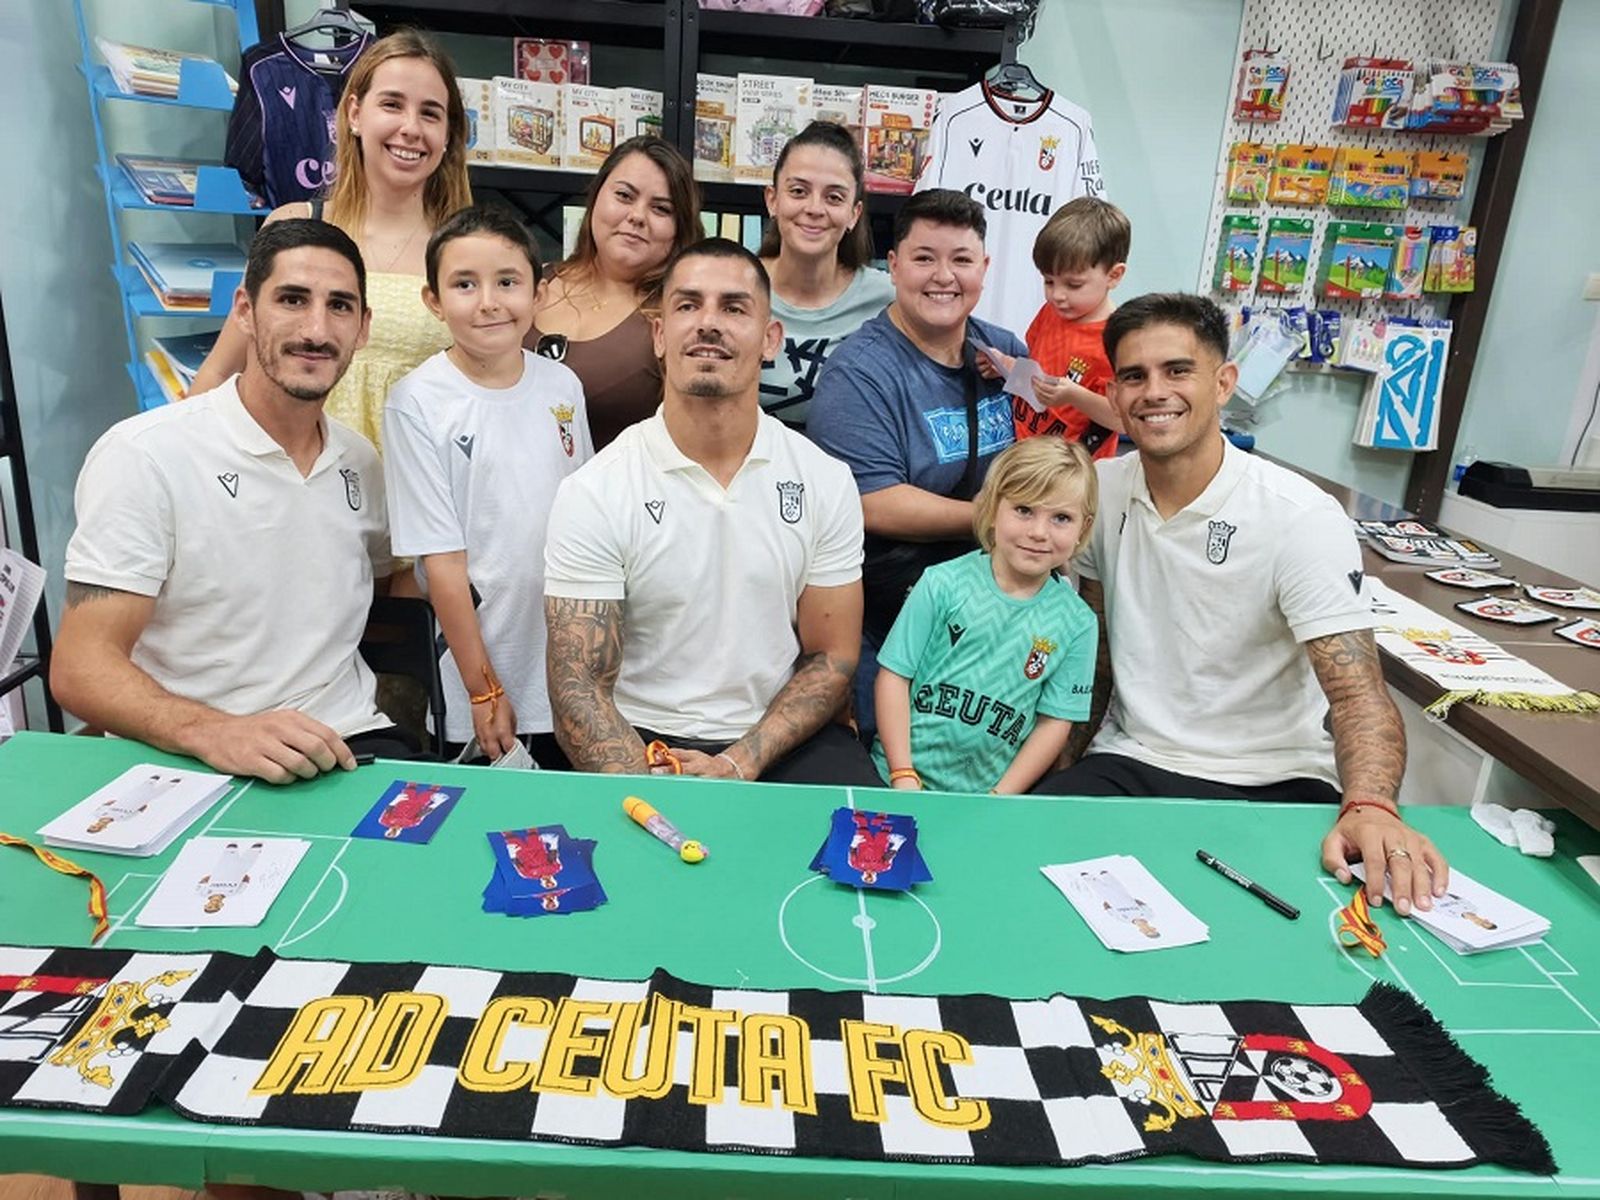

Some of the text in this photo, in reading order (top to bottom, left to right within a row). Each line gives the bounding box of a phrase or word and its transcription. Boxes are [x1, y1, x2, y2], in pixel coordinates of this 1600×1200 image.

[742, 79, 775, 89] STREET
[914, 683, 1026, 746] CEUTA
[248, 991, 992, 1134] AD CEUTA FC
